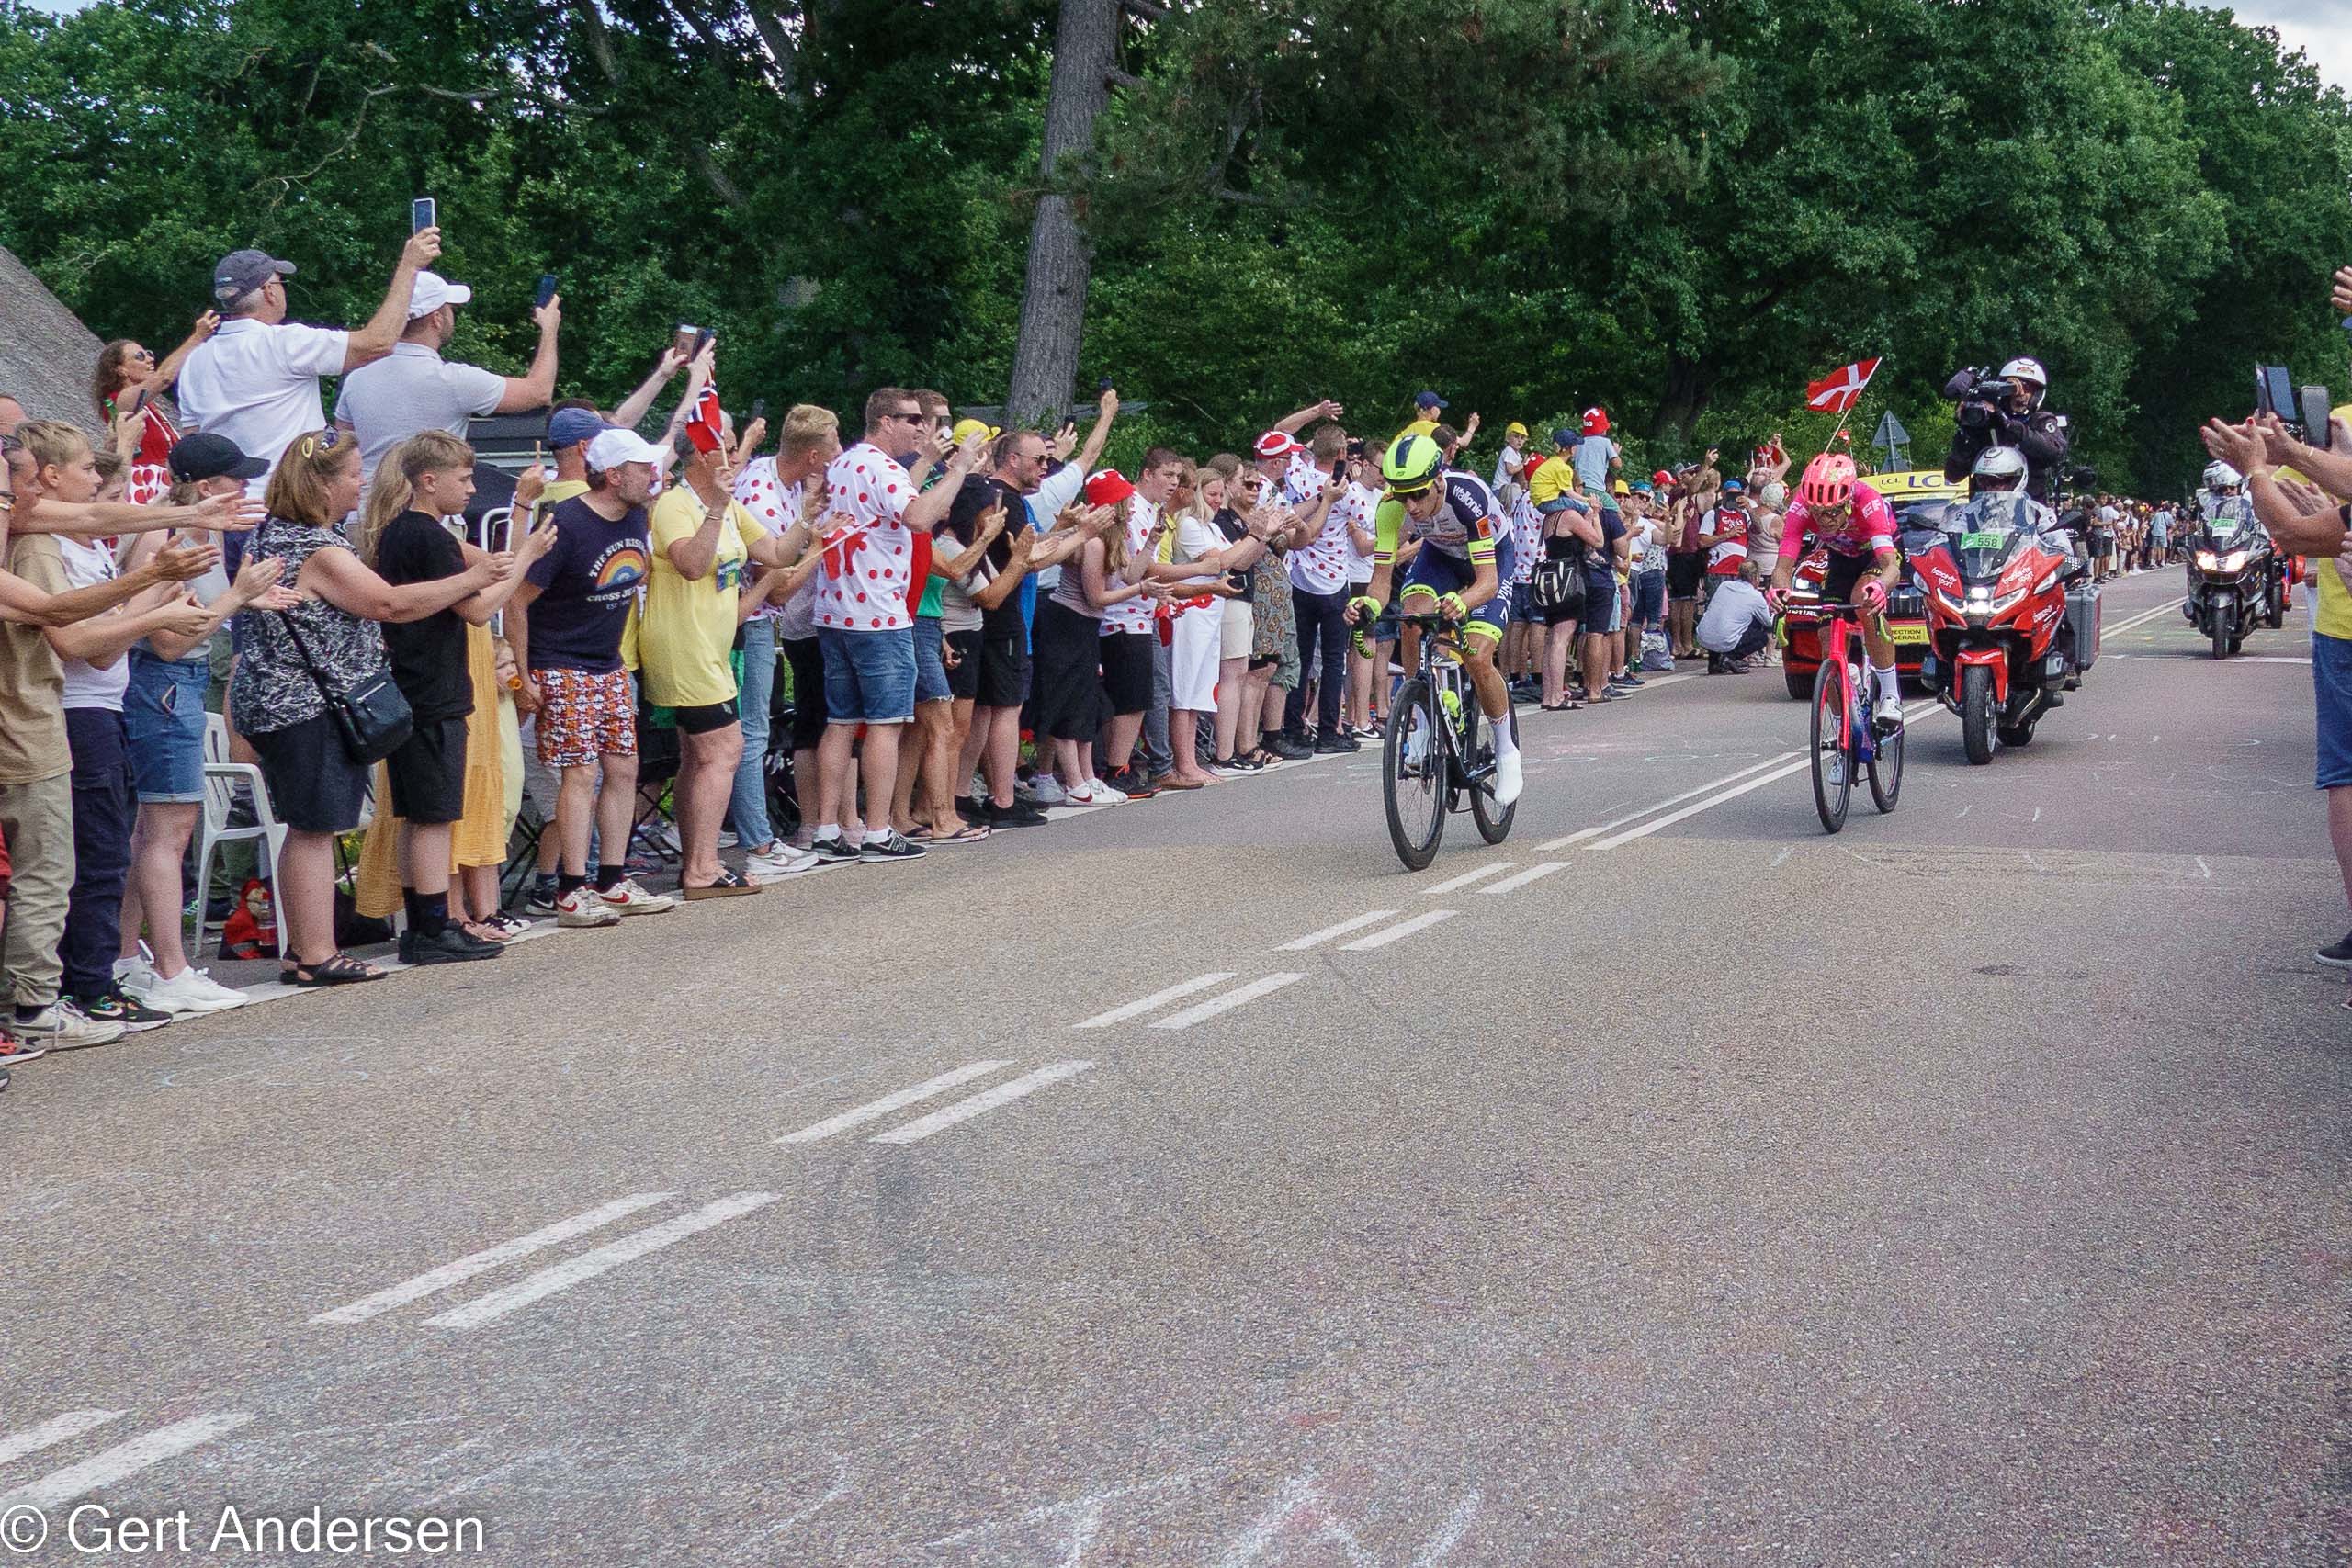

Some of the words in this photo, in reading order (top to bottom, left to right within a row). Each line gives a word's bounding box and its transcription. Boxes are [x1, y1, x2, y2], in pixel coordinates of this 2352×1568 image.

[1453, 484, 1483, 518] Wallonie
[1977, 537, 1998, 547] 558
[589, 554, 607, 578] THE
[605, 541, 625, 557] SUN
[586, 592, 622, 602] CROSS
